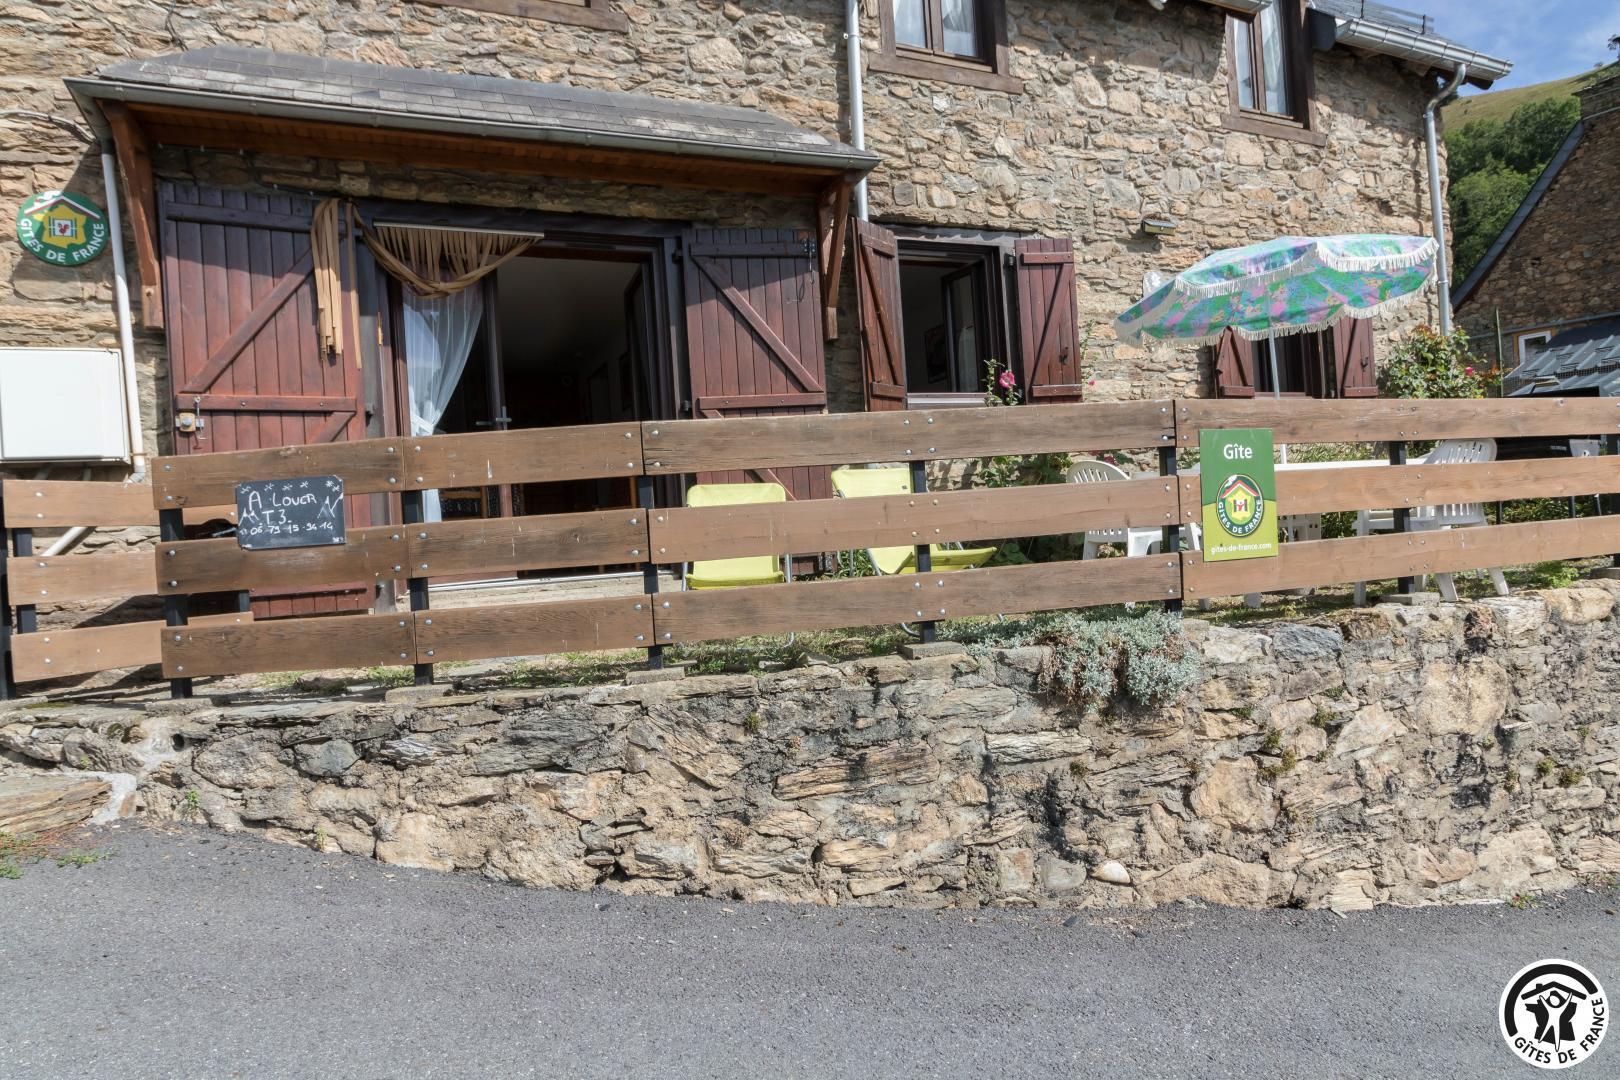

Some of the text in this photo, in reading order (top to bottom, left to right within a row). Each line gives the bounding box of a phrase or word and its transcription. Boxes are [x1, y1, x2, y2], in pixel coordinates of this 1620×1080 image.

[46, 249, 66, 263] DE
[72, 223, 105, 262] FRANCE
[1223, 442, 1253, 460] Gîte
[248, 490, 318, 512] A LOUER
[1232, 526, 1243, 534] DE
[1245, 500, 1263, 532] FRANCE
